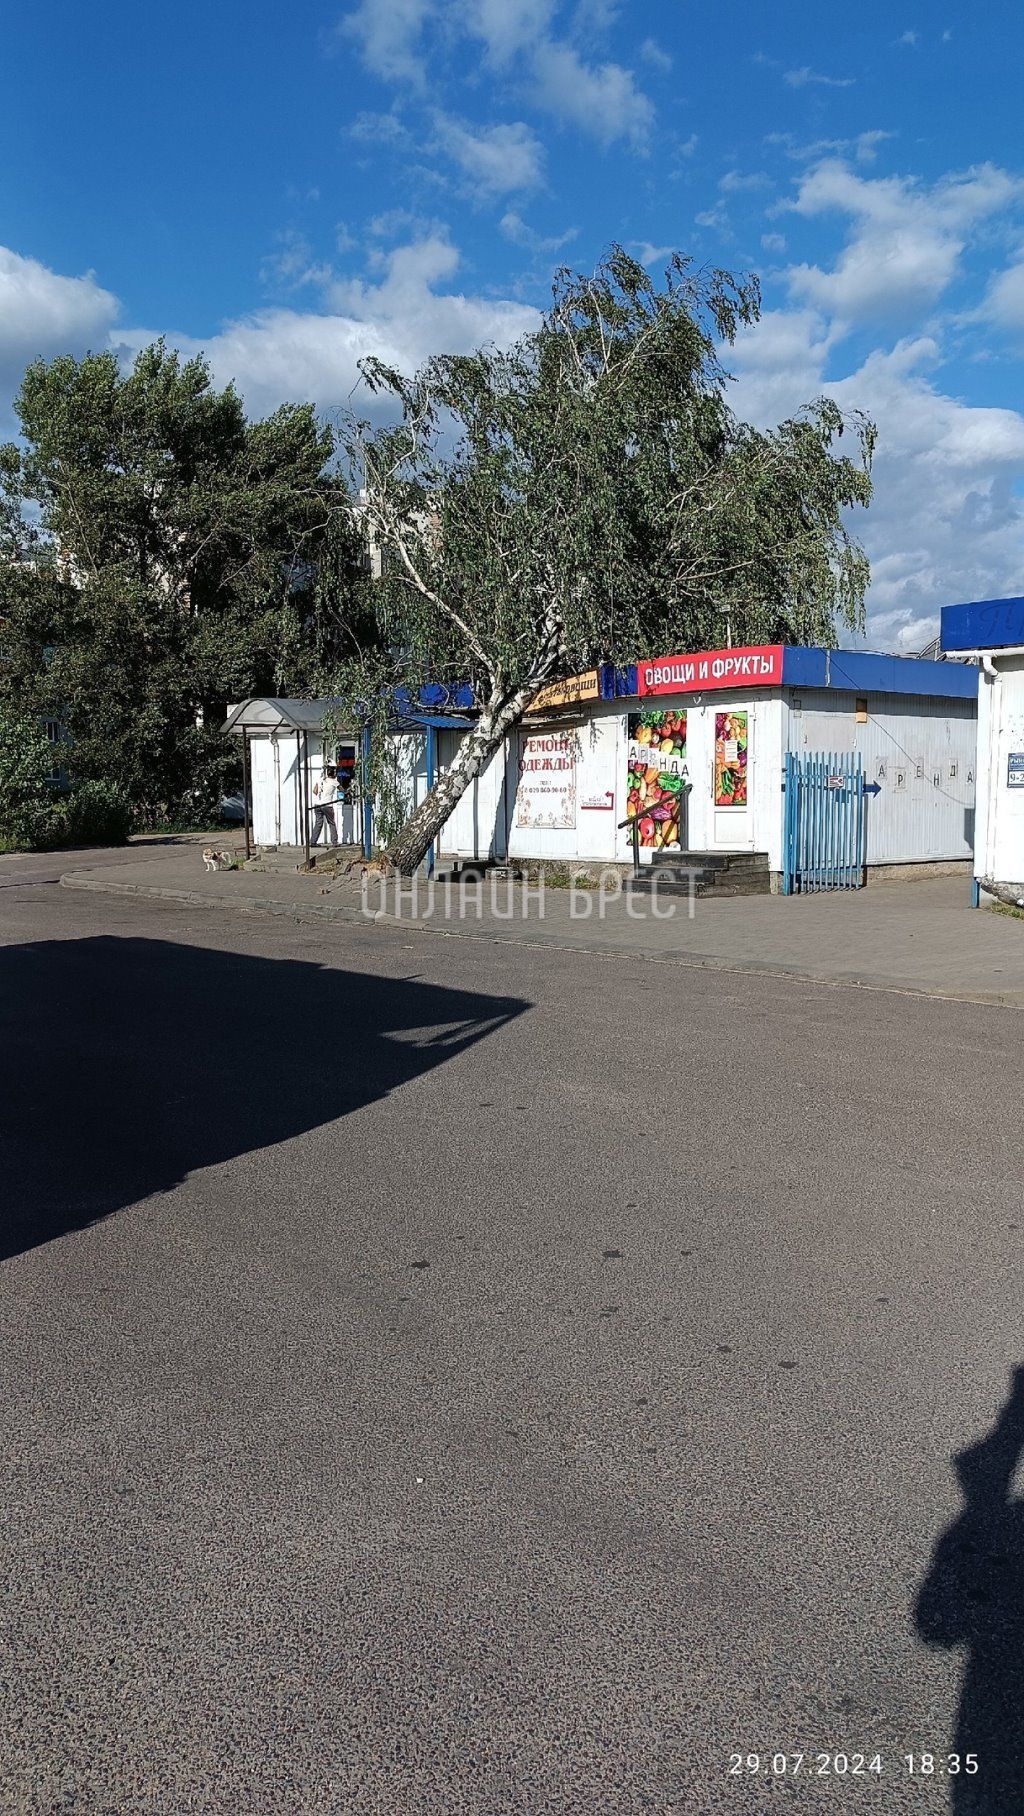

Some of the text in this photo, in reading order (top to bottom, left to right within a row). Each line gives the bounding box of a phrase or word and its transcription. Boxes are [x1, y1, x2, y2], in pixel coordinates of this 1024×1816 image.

[645, 655, 774, 685] ОВОЩИ И ФРУКТЫ
[519, 757, 574, 773] ОДЕЖДЫ
[629, 746, 690, 777] АРНДА
[878, 764, 974, 787] АРЕНДА
